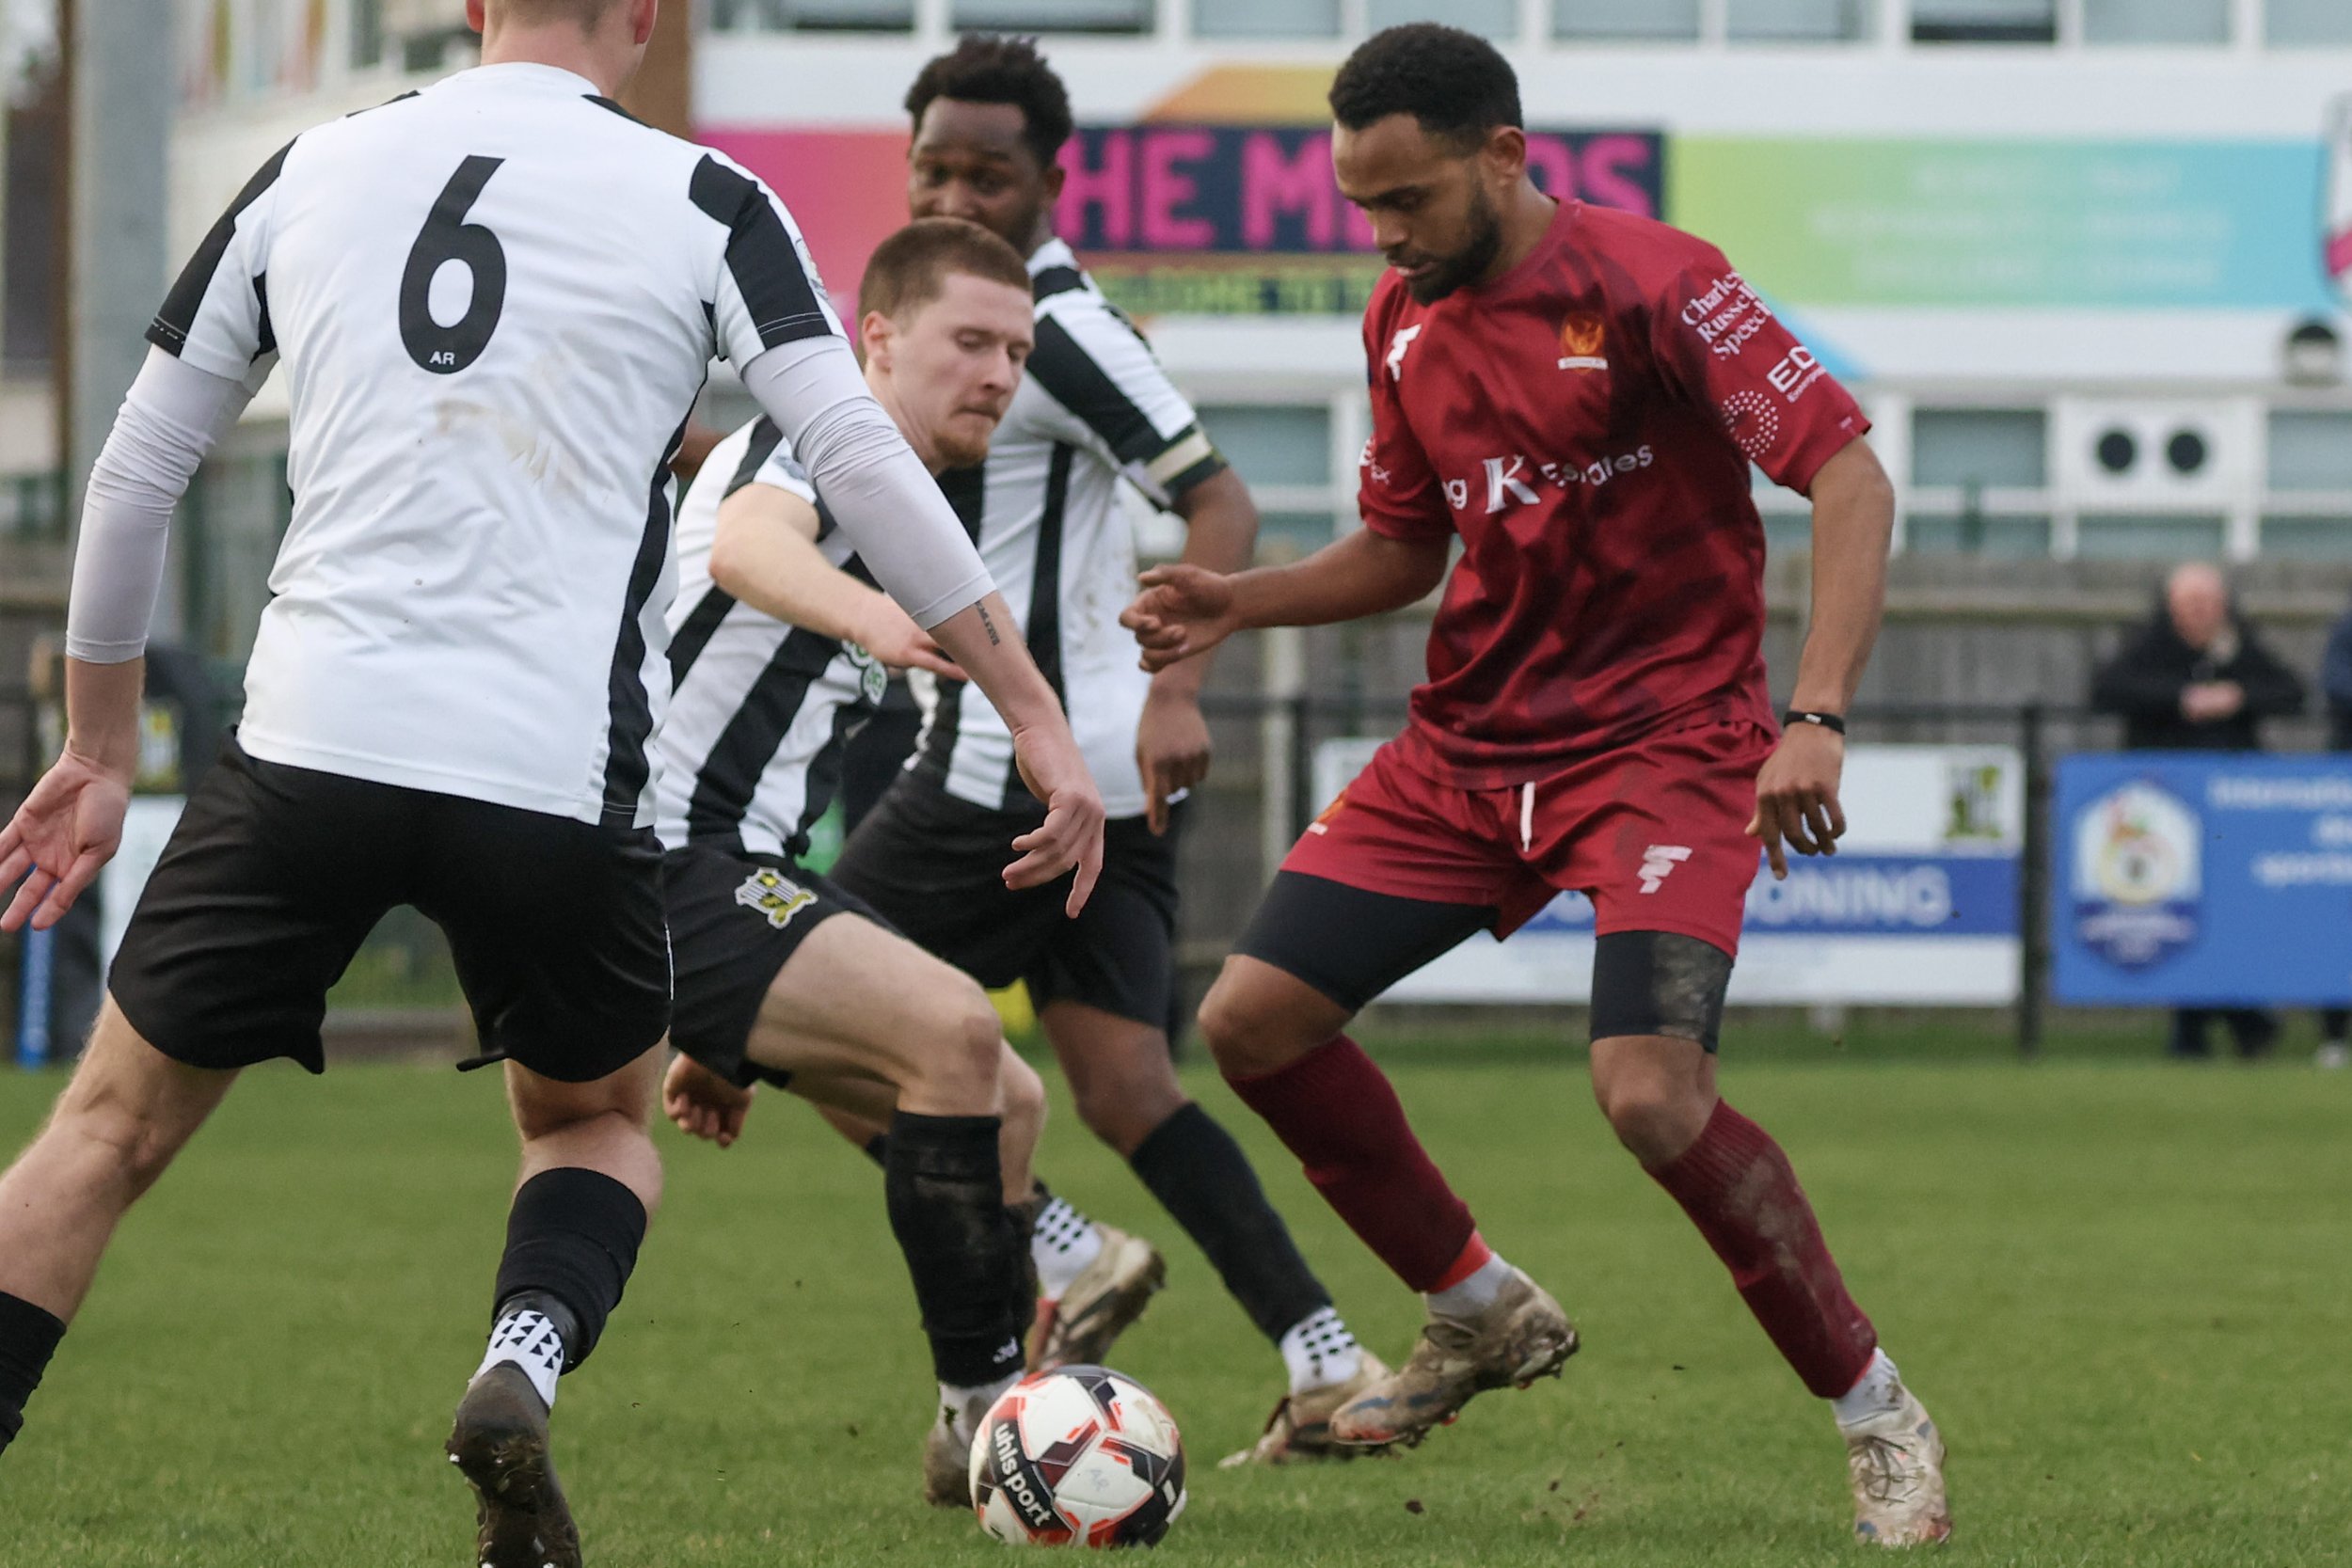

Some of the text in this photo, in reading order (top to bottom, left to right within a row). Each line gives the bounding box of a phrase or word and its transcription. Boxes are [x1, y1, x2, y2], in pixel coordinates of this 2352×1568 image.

[1051, 129, 1217, 247] HE
[398, 154, 507, 374] 6
[428, 351, 456, 366] AR
[993, 1422, 1053, 1528] uhlsport
